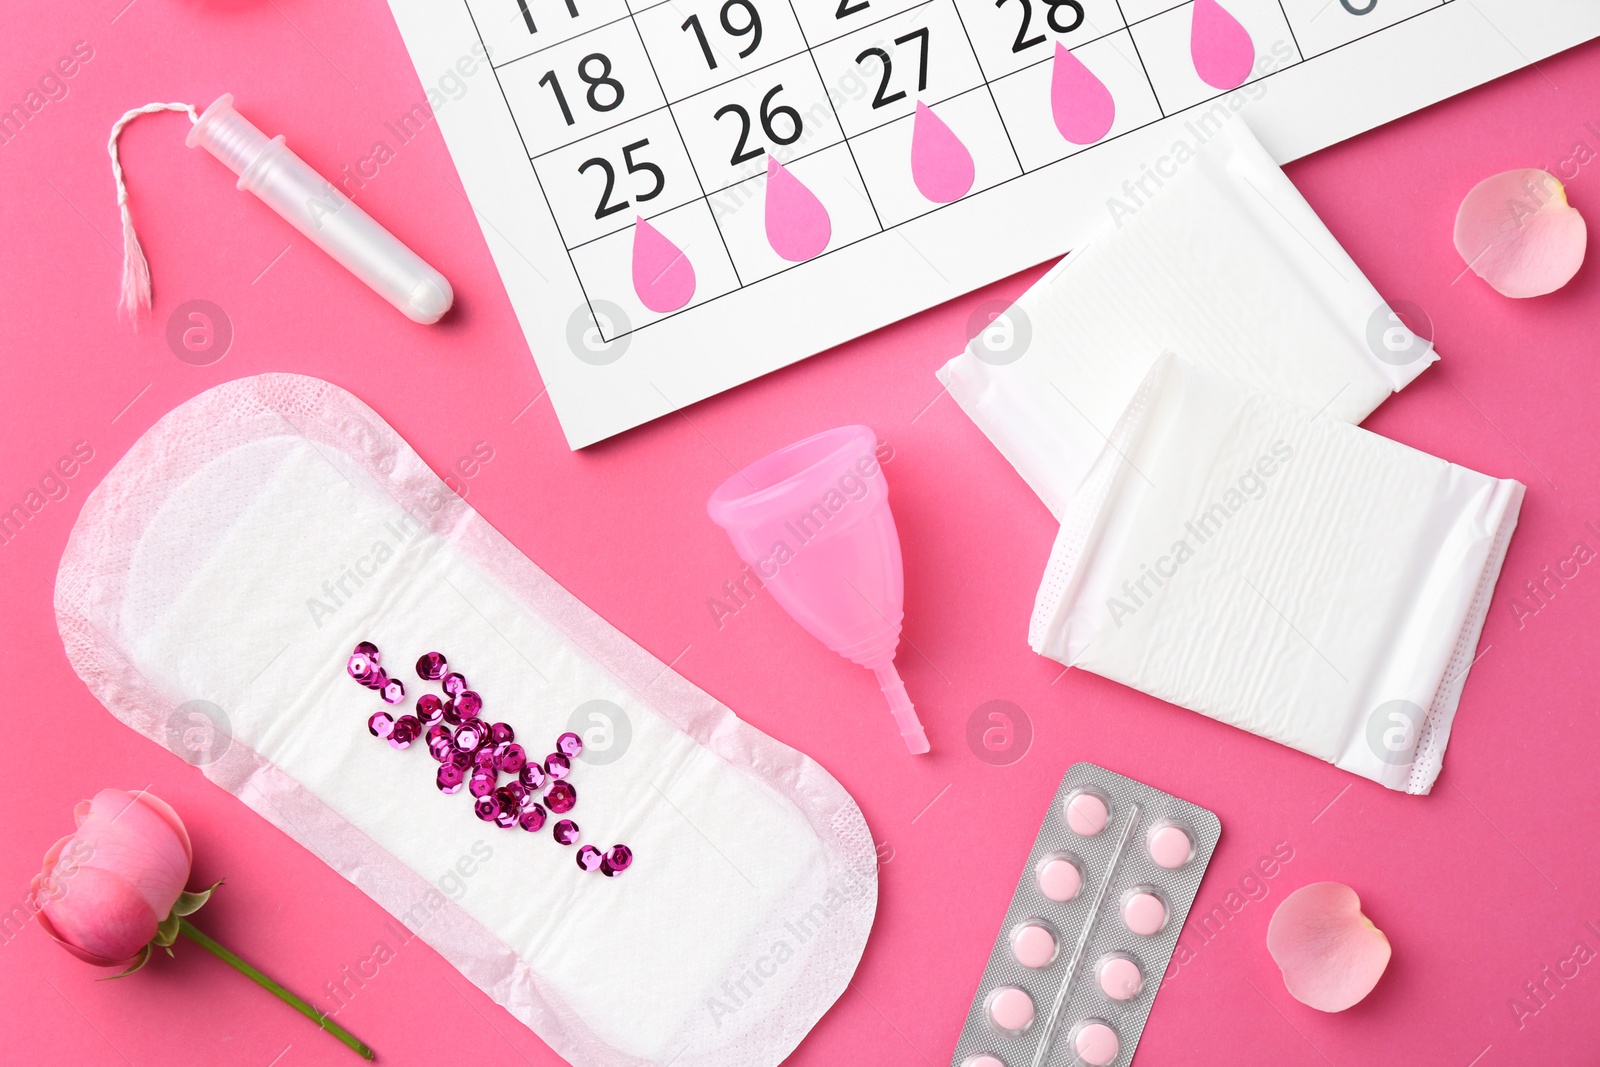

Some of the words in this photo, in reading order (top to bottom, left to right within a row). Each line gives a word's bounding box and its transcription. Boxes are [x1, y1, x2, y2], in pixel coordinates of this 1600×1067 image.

[538, 52, 625, 127] 18
[680, 0, 763, 71] 19
[577, 137, 665, 221] 25
[713, 83, 804, 167] 26
[854, 26, 930, 110] 27
